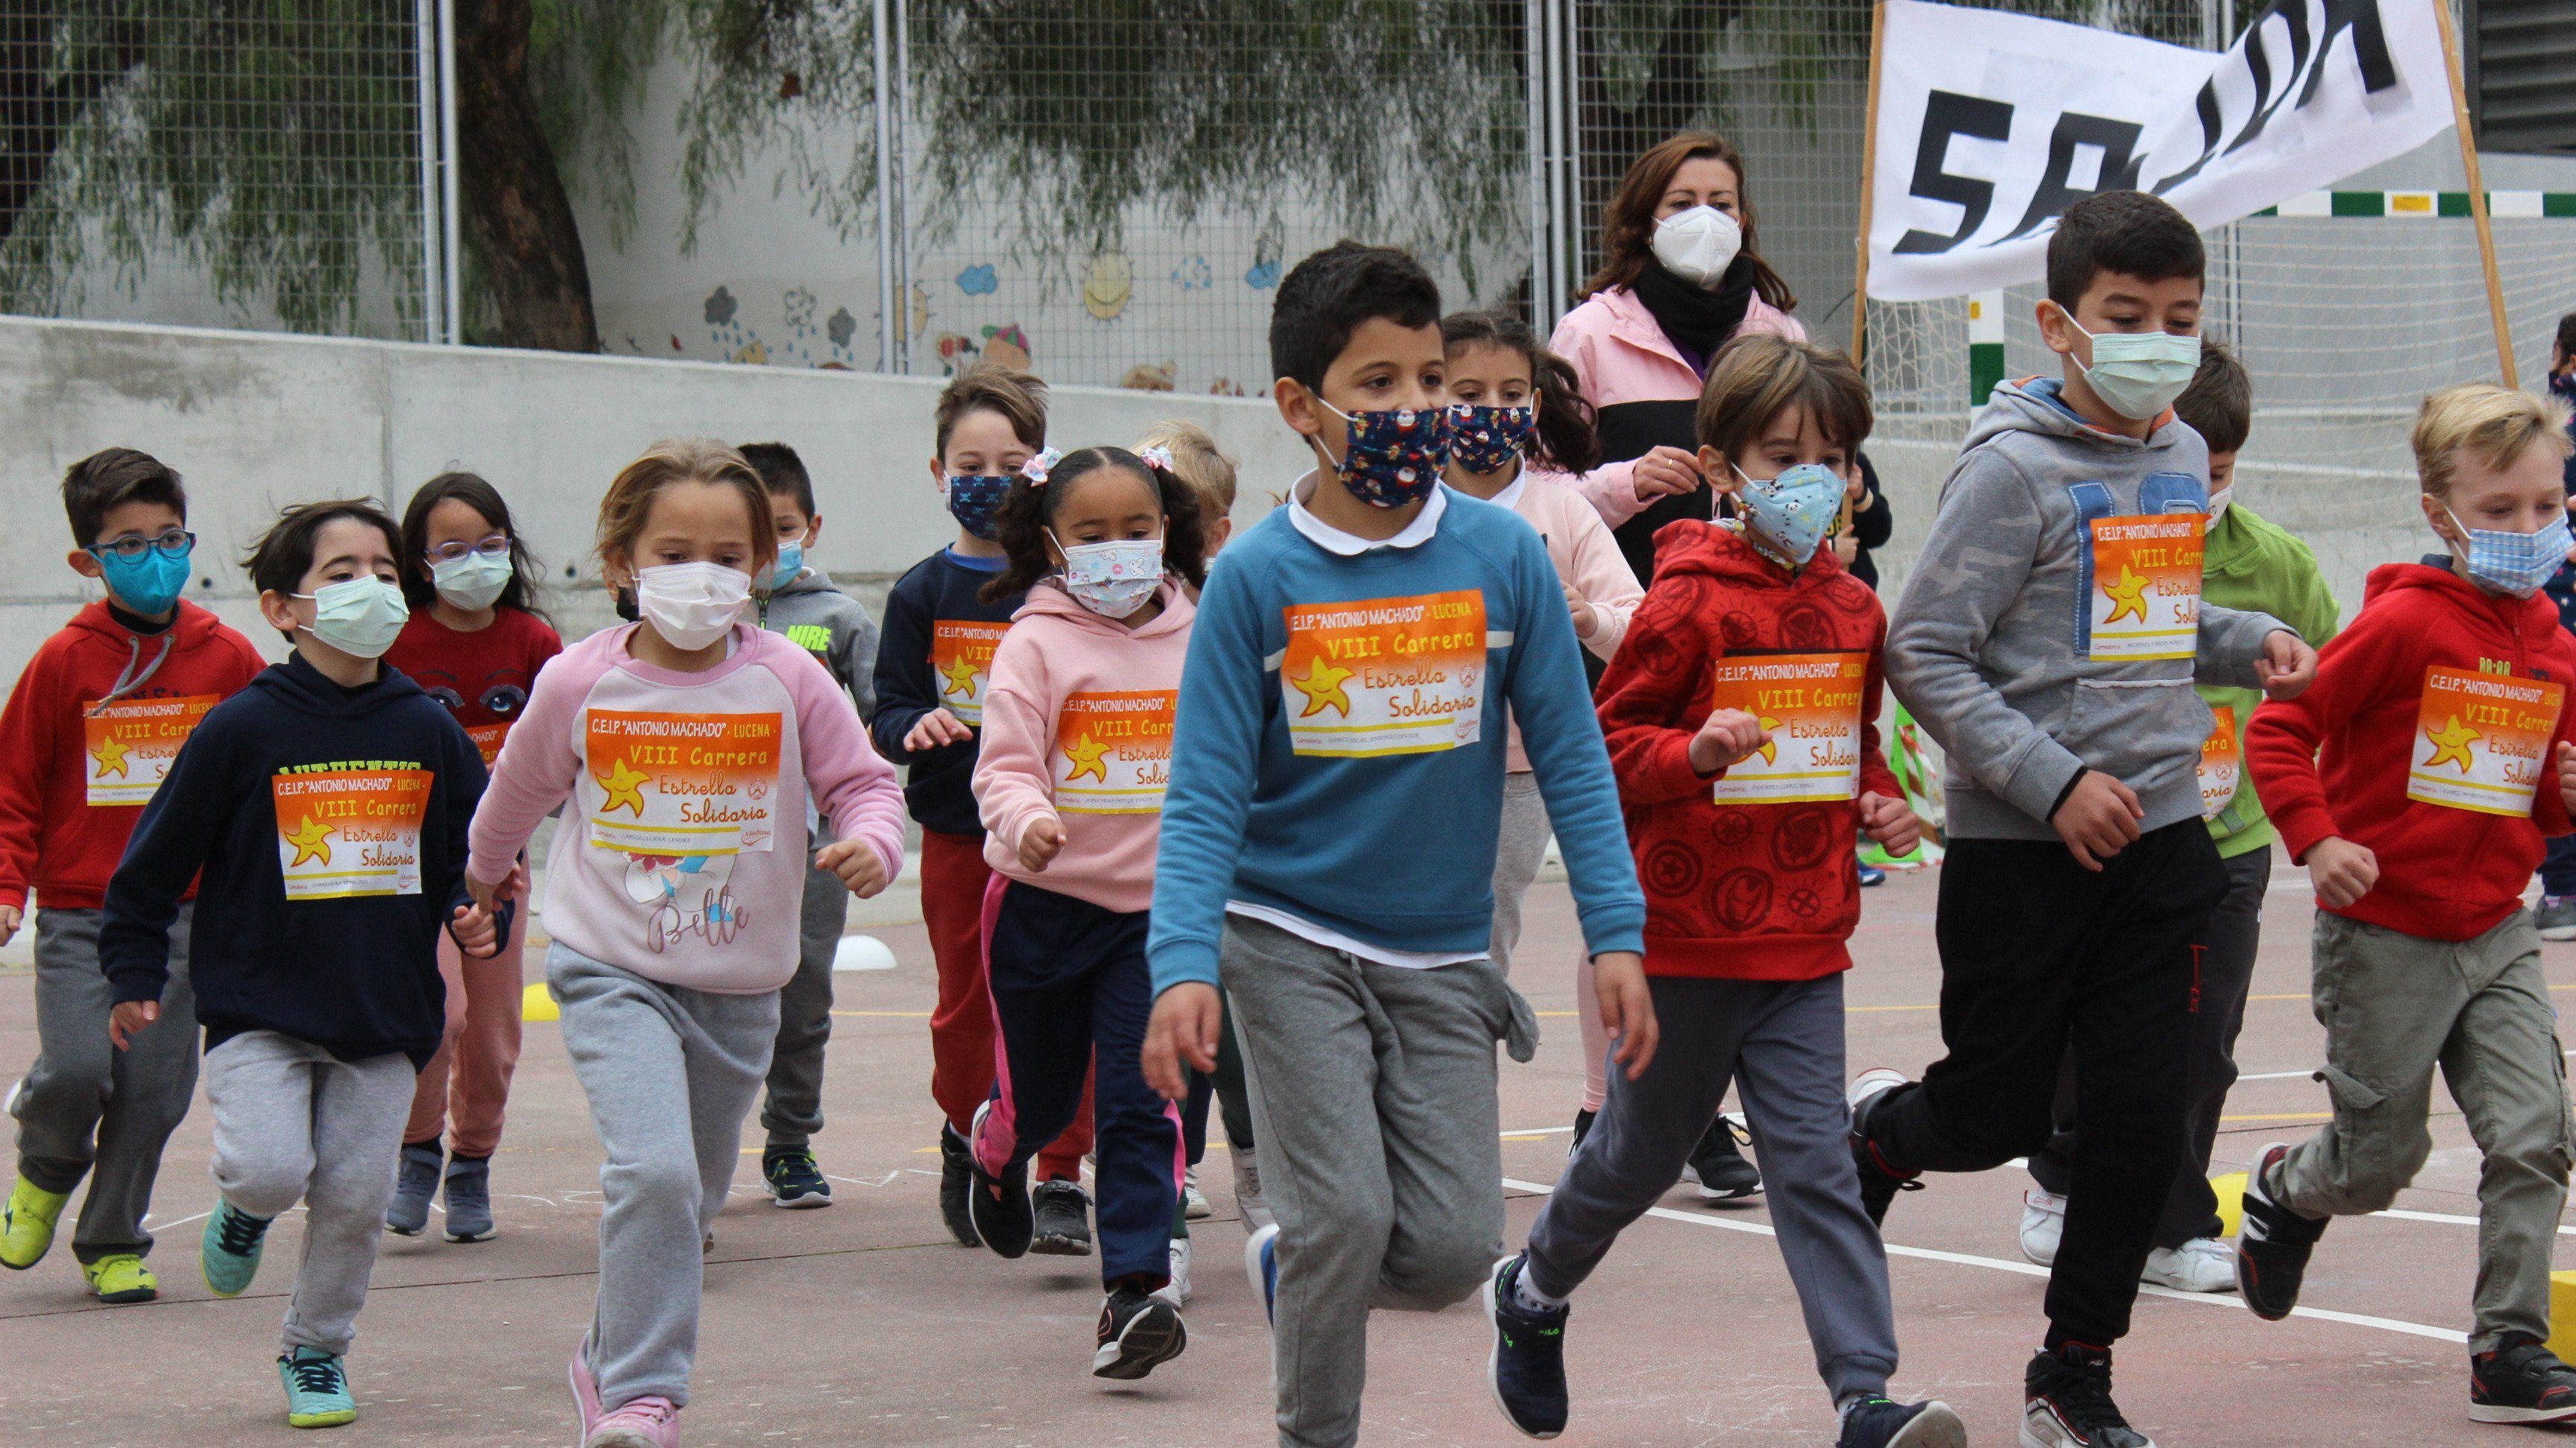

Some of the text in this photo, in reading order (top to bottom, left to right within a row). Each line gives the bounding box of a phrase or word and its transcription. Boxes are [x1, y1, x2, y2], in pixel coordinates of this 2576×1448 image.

[2097, 526, 2123, 542] C.E.I.P.
[2132, 547, 2168, 569] VIII
[1368, 605, 1425, 625] MACHADO"
[1433, 602, 1472, 620] LUCENA
[938, 627, 960, 638] C.E.I.P.
[1327, 631, 1475, 660] VIII Carrera
[1364, 656, 1447, 689] Estrella
[1717, 667, 1749, 682] C.E.I.P.
[1796, 663, 1840, 680] MACHADO"
[2430, 674, 2460, 692] C.E.I.P.
[1125, 698, 1166, 712] MACHADO"
[1389, 689, 1477, 718] Solidaria
[1757, 689, 1805, 709] VIII
[1790, 710, 1849, 739] Estrella
[2466, 703, 2510, 726] VIII
[114, 724, 151, 740] VIII
[592, 718, 770, 739] C.E.I.P. "ANTONIO MACHADO" LUCENA
[1093, 720, 1132, 736] VIII
[630, 745, 768, 766] VIII Carrera
[278, 777, 420, 796] C.E.I.P. "ANTONIO MACHADO" LUCENA
[660, 770, 737, 795] Estrella
[315, 799, 417, 818] VIII Carrera
[681, 797, 768, 823] Solidaria
[343, 819, 399, 842] Estrella
[361, 844, 416, 866] Solidaria
[647, 884, 750, 955] Belle
